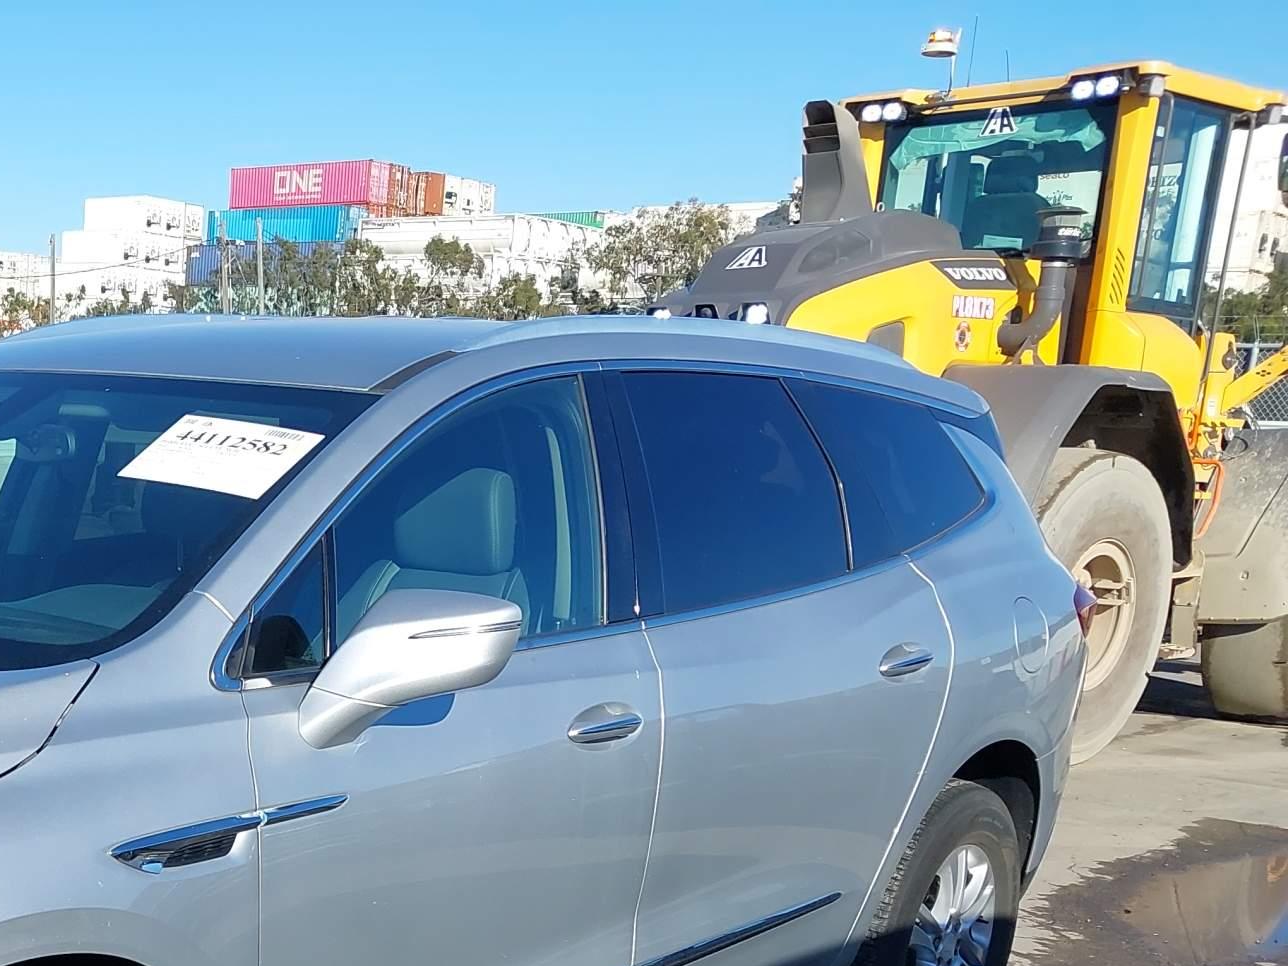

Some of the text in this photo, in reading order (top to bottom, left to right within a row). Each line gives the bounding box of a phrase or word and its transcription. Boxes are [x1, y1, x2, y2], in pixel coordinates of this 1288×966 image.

[274, 168, 323, 194] ONE
[943, 267, 1007, 281] VOLVO
[175, 430, 289, 456] 44112582
